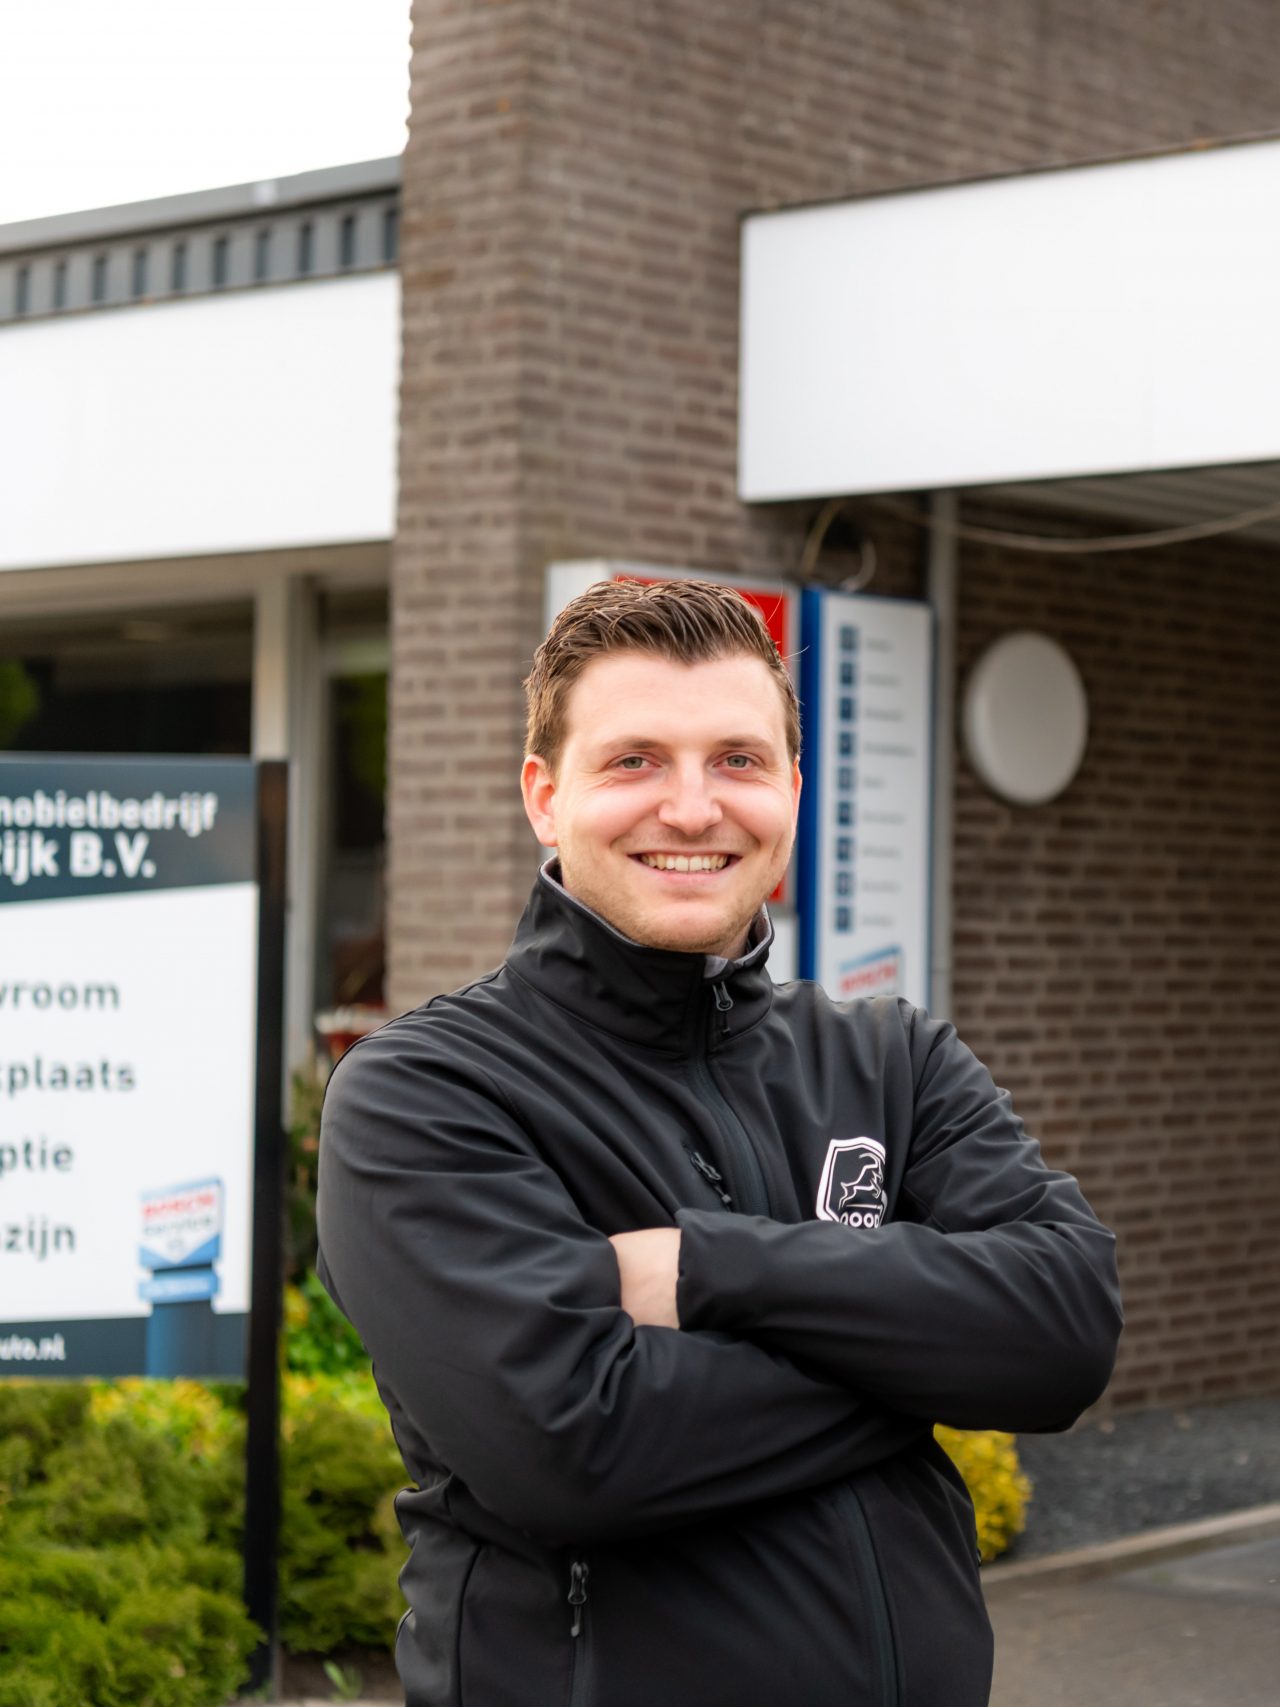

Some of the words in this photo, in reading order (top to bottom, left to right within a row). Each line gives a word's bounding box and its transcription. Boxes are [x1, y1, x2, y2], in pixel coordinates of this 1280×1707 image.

[0, 829, 60, 886] ijk
[69, 831, 157, 879] B.V.
[0, 1053, 137, 1100] plaats
